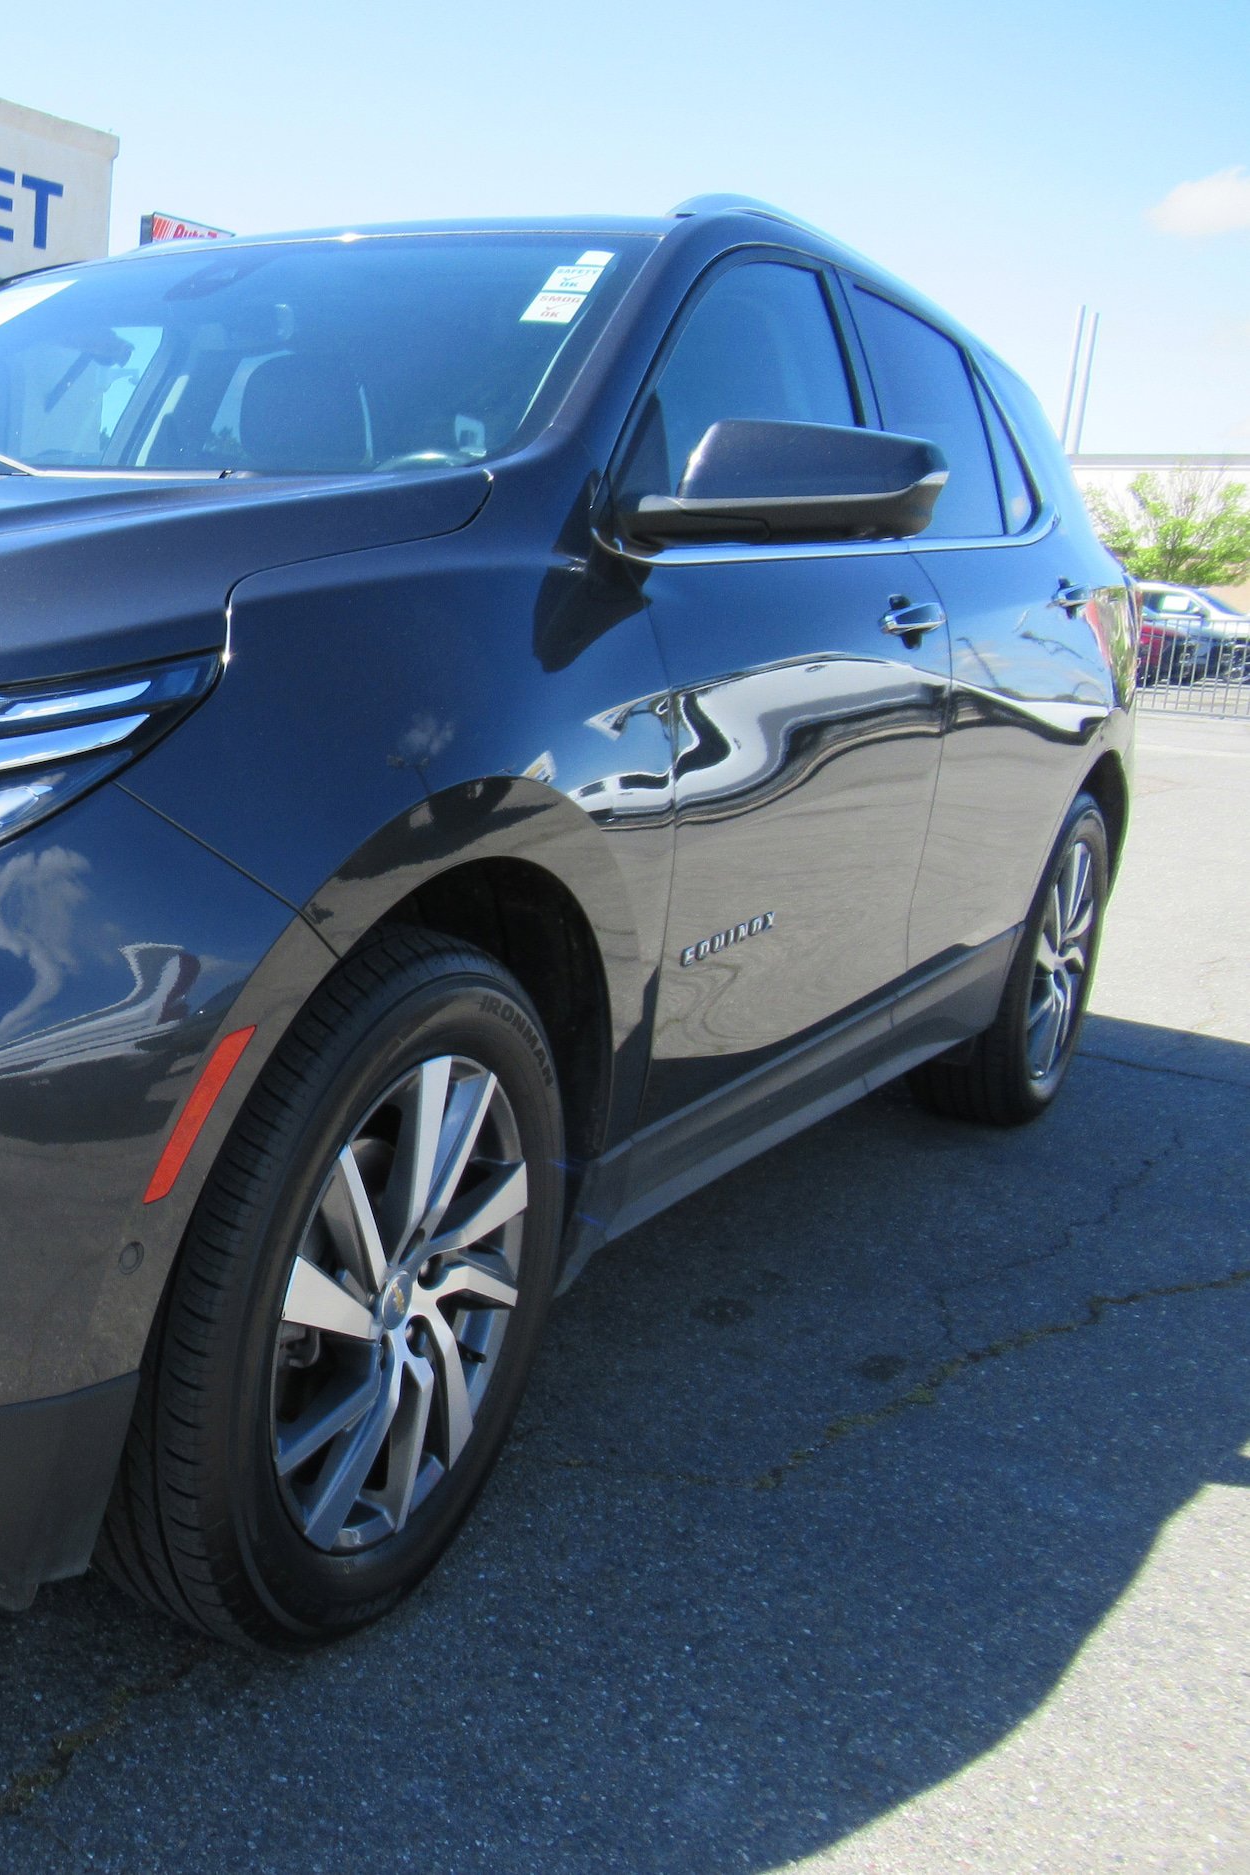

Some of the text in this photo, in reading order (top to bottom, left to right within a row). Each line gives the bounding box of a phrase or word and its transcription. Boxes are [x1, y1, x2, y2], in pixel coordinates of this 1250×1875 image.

[540, 295, 582, 303] SMOG
[540, 310, 560, 318] OK
[680, 911, 775, 968] EQUINOX
[479, 995, 554, 1088] IRONMAN
